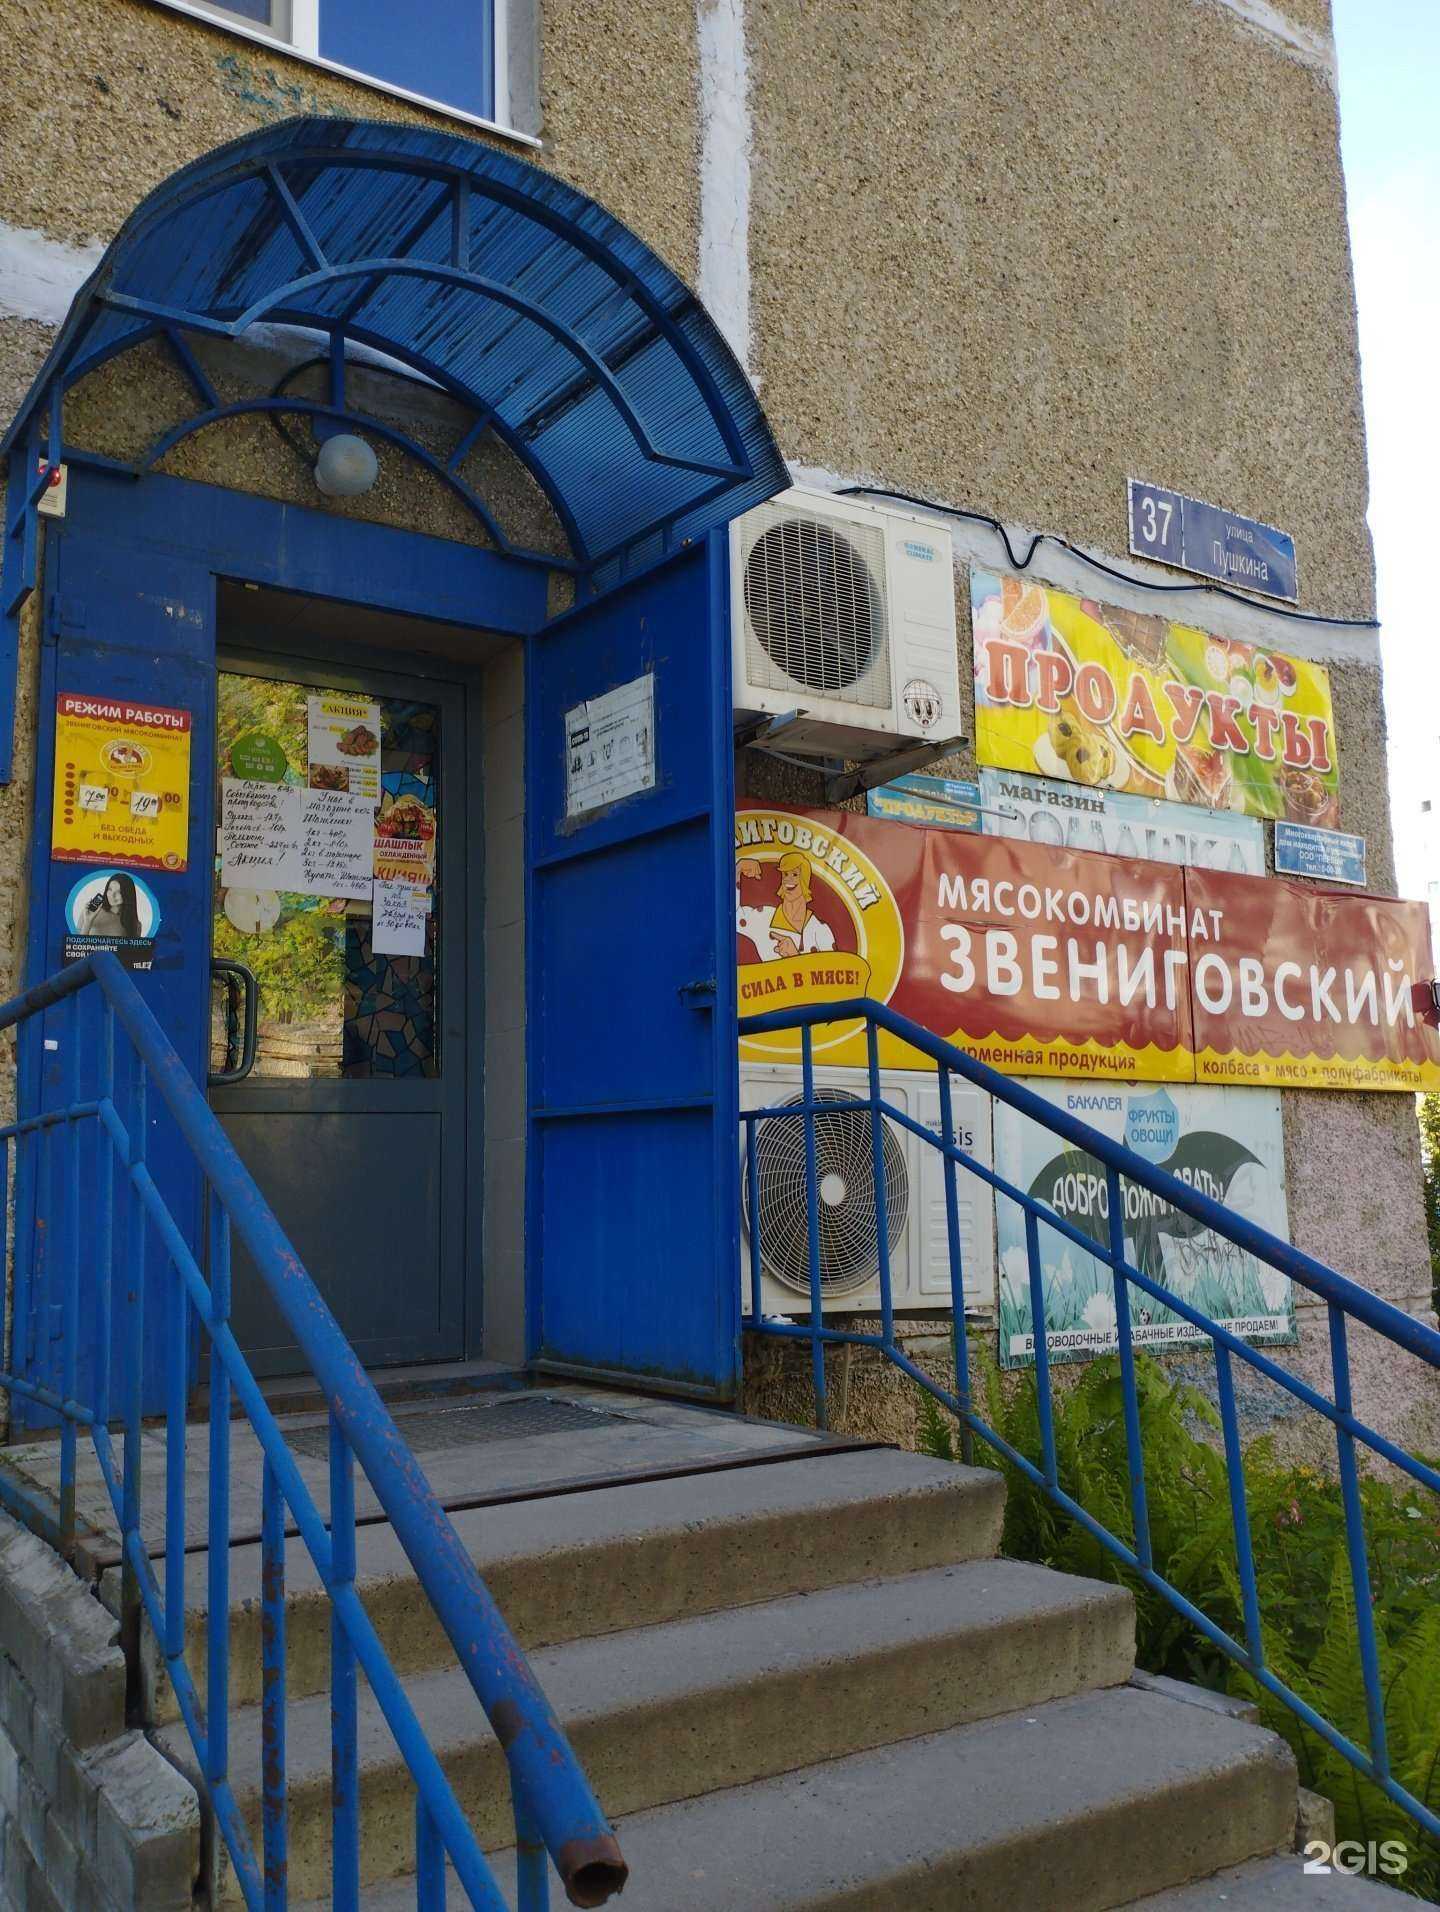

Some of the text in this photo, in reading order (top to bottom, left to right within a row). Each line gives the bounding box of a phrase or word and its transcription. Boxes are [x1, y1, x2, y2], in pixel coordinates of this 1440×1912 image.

[1142, 497, 1172, 545] 37
[1225, 523, 1254, 544] улица
[1213, 541, 1269, 581] Пушкина
[65, 700, 184, 727] РЕЖИМ РАБОТЫ
[984, 640, 1331, 772] ПРОДУКТЫ
[999, 782, 1107, 815] магазин
[93, 832, 154, 845] И ВЫХОДНЫХ
[101, 823, 147, 835] БЕЗ ОБЕДА
[373, 838, 424, 850] ШАШЛЫК
[938, 872, 1223, 942] МЯСОКОМБИНАТ
[741, 970, 859, 1000] СИЛА В МЯСЕ!
[940, 924, 1415, 1029] ЗВЕНИГОВСКИЙ
[1049, 1051, 1136, 1070] продукция
[1203, 1059, 1422, 1086] колбаса мясо полуфабрикаты
[1067, 1095, 1123, 1111] БАКАЛЕЯ
[1128, 1109, 1176, 1124] ФРУКТЫ
[1131, 1128, 1174, 1144] ОВОЩИ
[1051, 1173, 1110, 1219] ДОБРО
[1025, 1332, 1112, 1350] ВОВОДОЧНЫЕ
[1129, 1327, 1174, 1344] АБАЧНЫЕ
[1234, 1321, 1279, 1333] ПРОДАЕМ!
